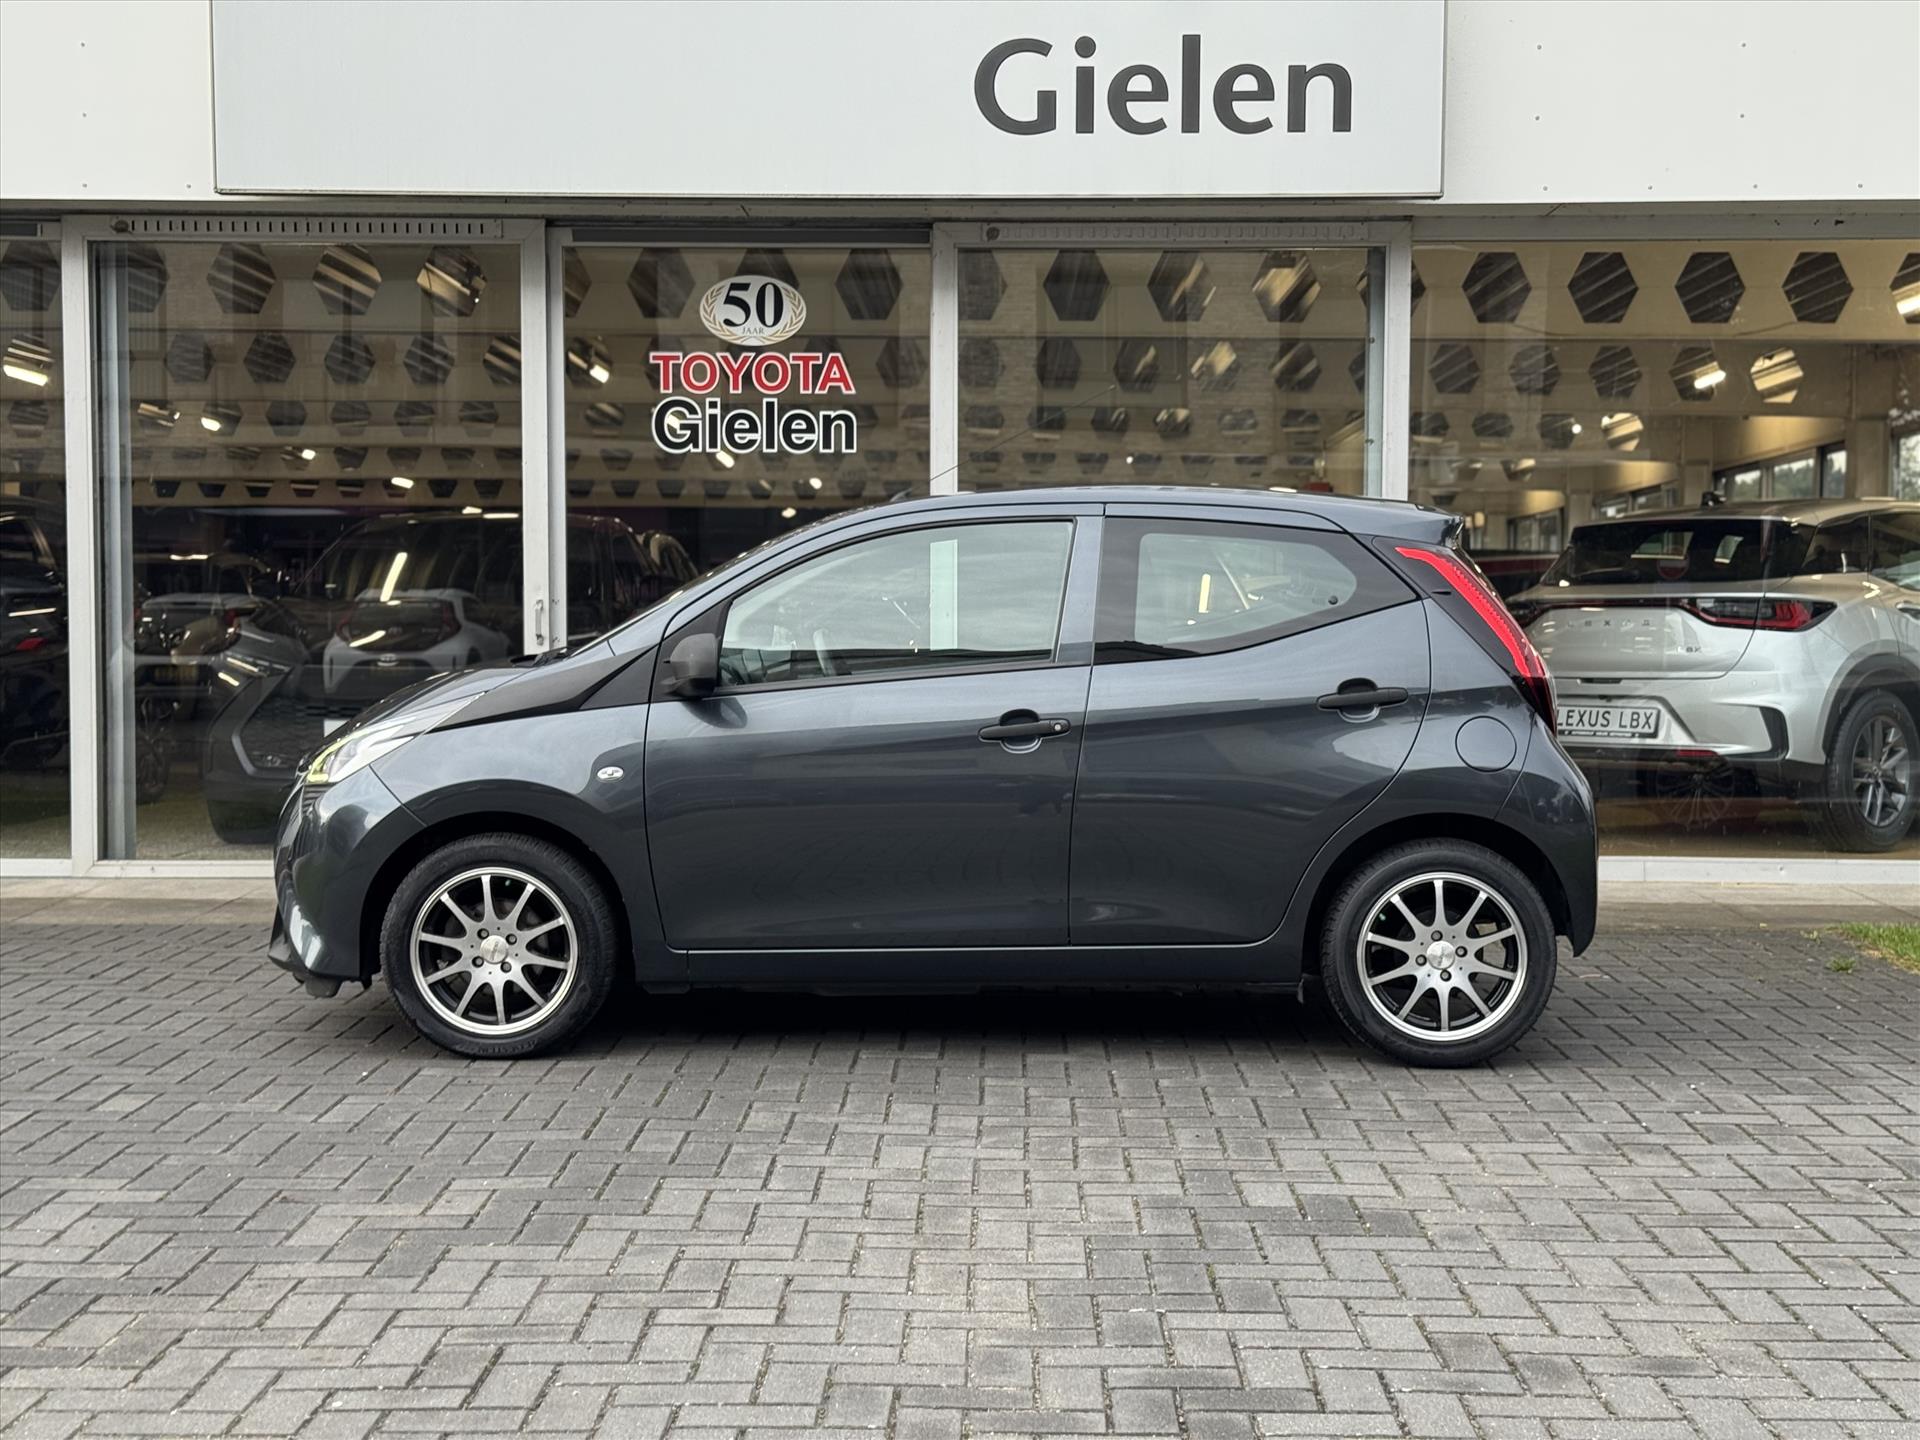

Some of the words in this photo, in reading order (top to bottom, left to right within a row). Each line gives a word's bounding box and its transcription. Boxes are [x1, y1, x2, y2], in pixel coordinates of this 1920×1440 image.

[974, 34, 1352, 136] Gielen
[722, 282, 784, 328] 50
[742, 327, 765, 335] JAAR
[650, 352, 855, 394] TOYOTA
[652, 397, 857, 453] Gielen
[1557, 708, 1611, 728] LEXUS
[1618, 710, 1653, 729] LBX
